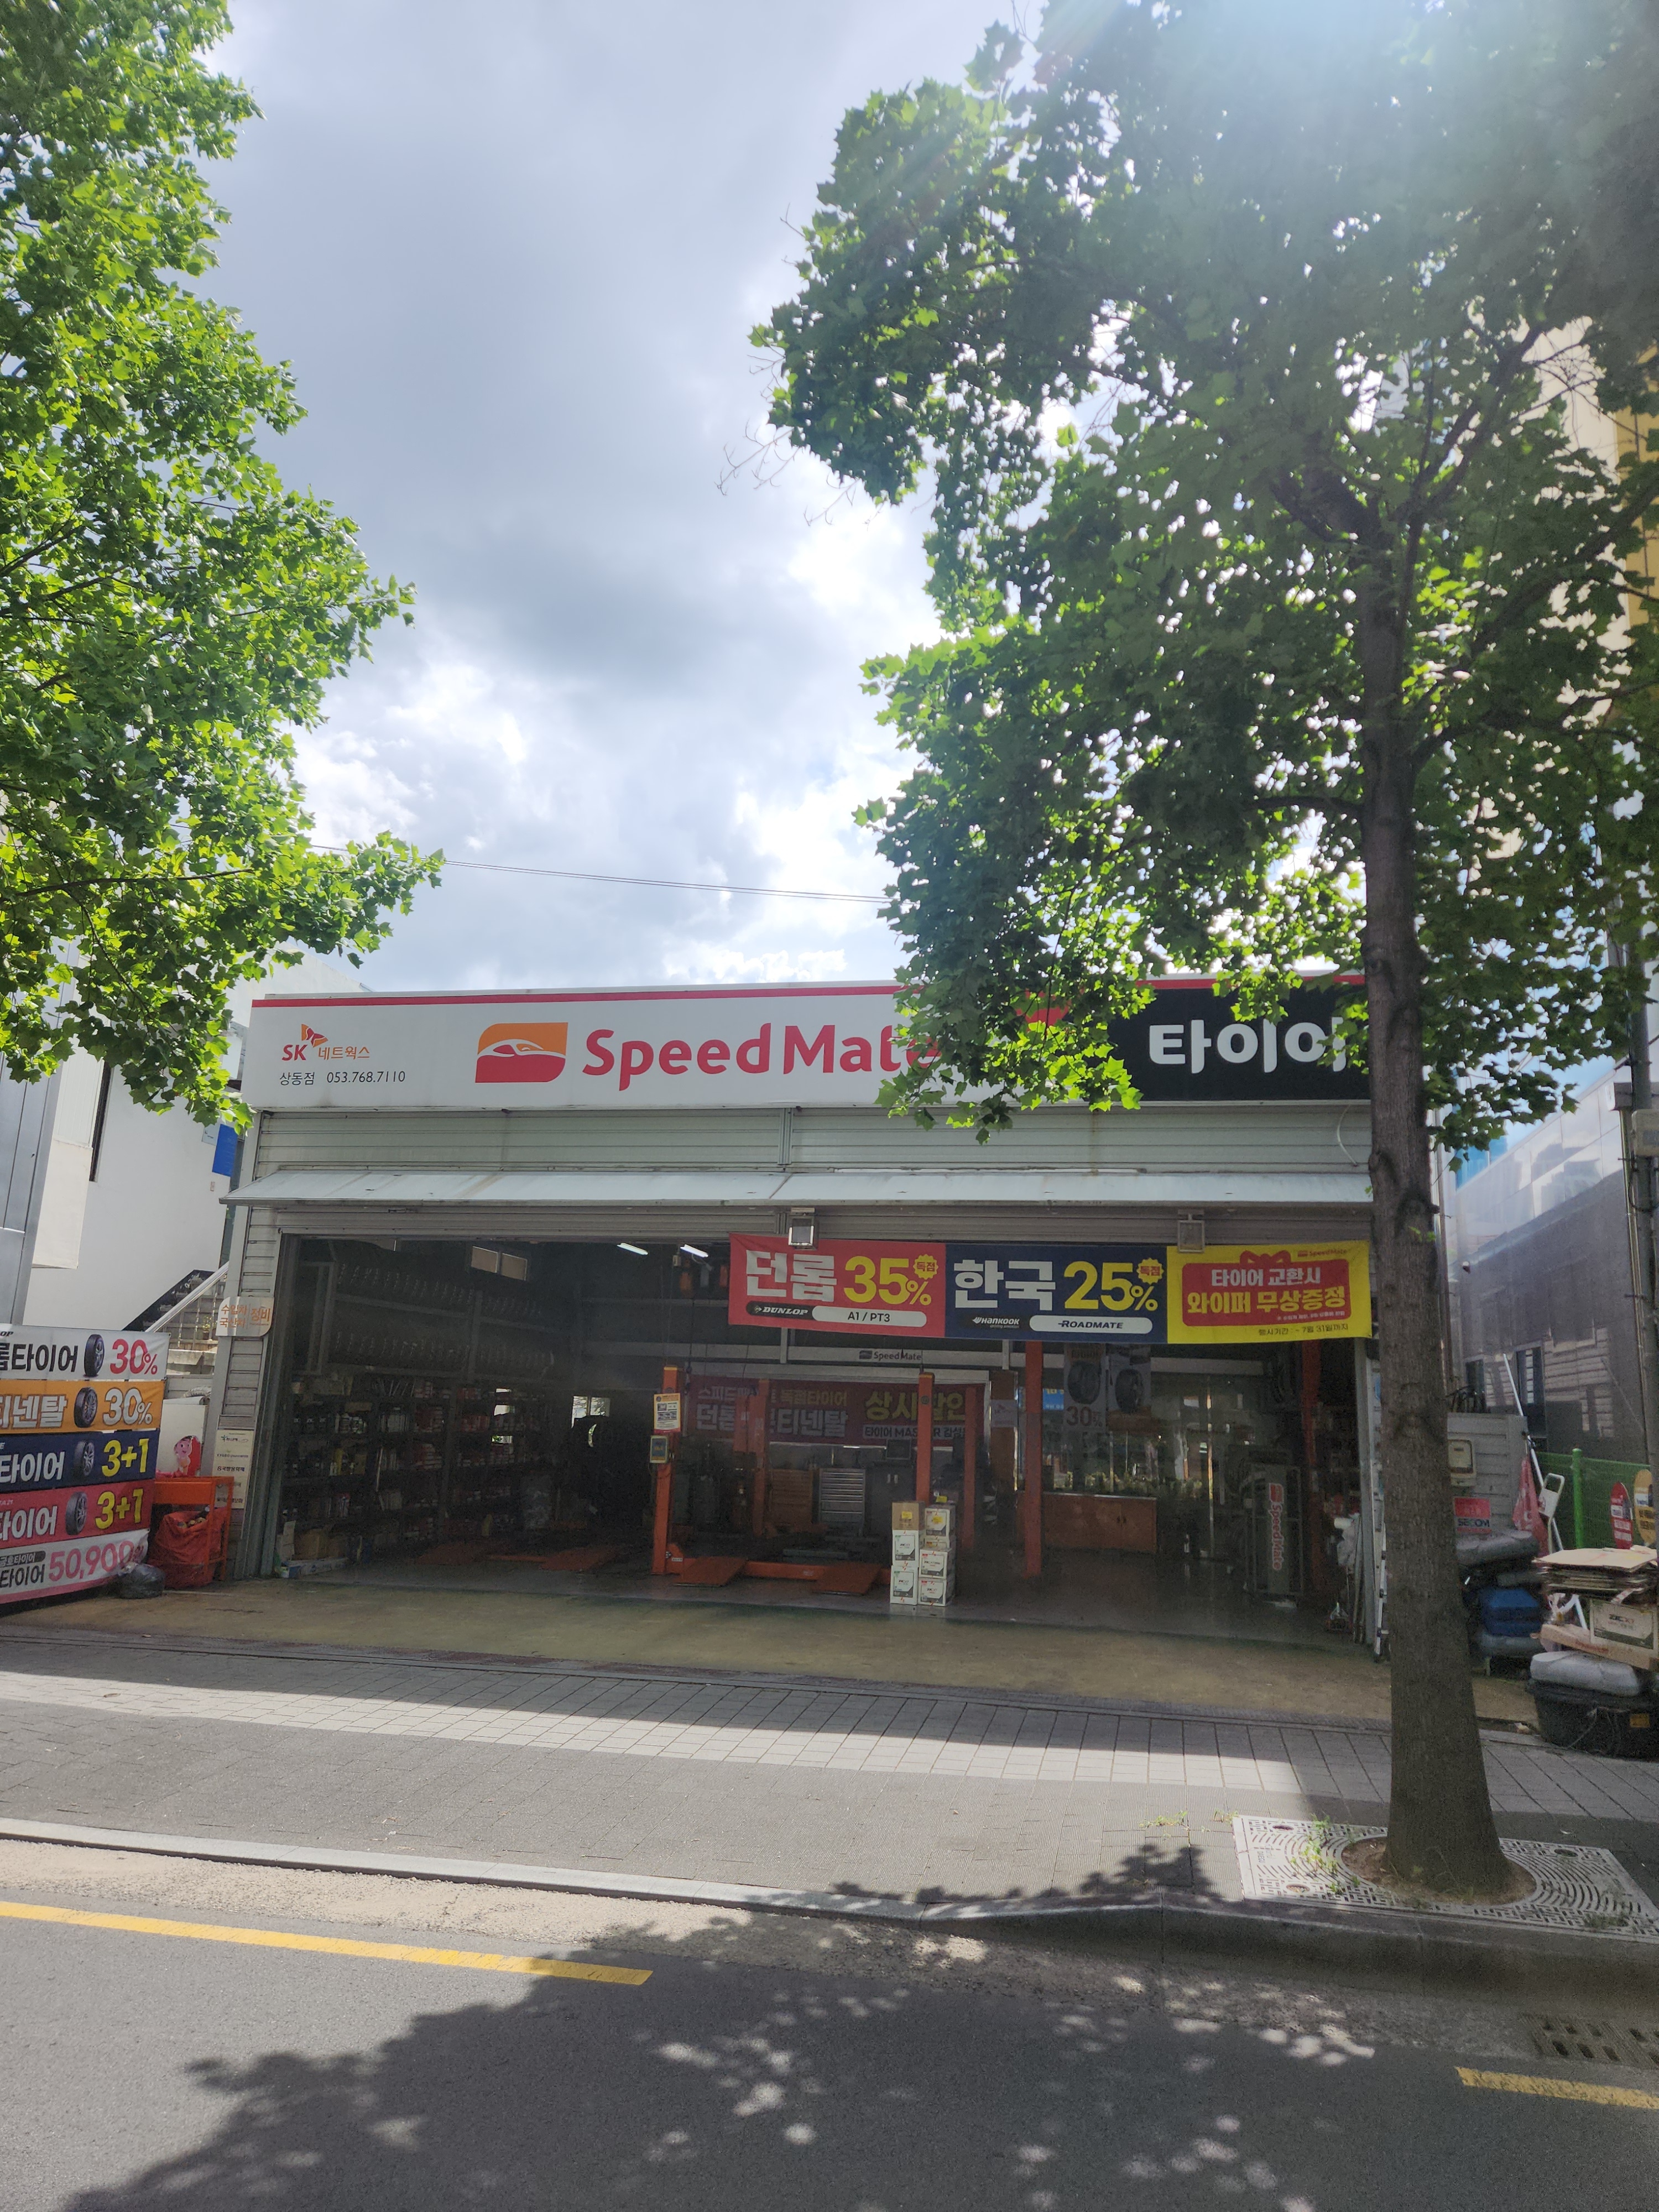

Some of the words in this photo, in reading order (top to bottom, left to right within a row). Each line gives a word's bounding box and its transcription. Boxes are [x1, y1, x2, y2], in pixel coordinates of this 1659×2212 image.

[282, 1044, 307, 1061] SK
[318, 1046, 370, 1060] 네트웍스
[1149, 1017, 1346, 1073] 타이어
[279, 1072, 315, 1086] 상동점
[327, 1071, 405, 1083] 053.768.7110
[746, 1250, 837, 1302] 던롭
[844, 1255, 932, 1306] 35%
[954, 1260, 1056, 1311] 한국
[1063, 1261, 1158, 1311] 25%
[1212, 1269, 1263, 1286] 타이어
[1268, 1267, 1321, 1285] 교환시
[1187, 1292, 1251, 1313] 와이퍼
[1257, 1286, 1345, 1312] 무상증정
[221, 1305, 247, 1315] 수입차
[251, 1308, 270, 1322] 정비
[762, 1306, 808, 1315] DUNLOP
[848, 1312, 859, 1320] A1
[862, 1312, 868, 1321] /
[870, 1313, 890, 1322] PT3
[220, 1317, 246, 1328] 국산차
[111, 1339, 158, 1375] 30%
[874, 1351, 922, 1361] SpeedMate
[102, 1389, 152, 1425] 30%
[865, 1427, 892, 1436] 타이어
[102, 1438, 149, 1477] 3+1
[95, 1489, 143, 1530] 3+1
